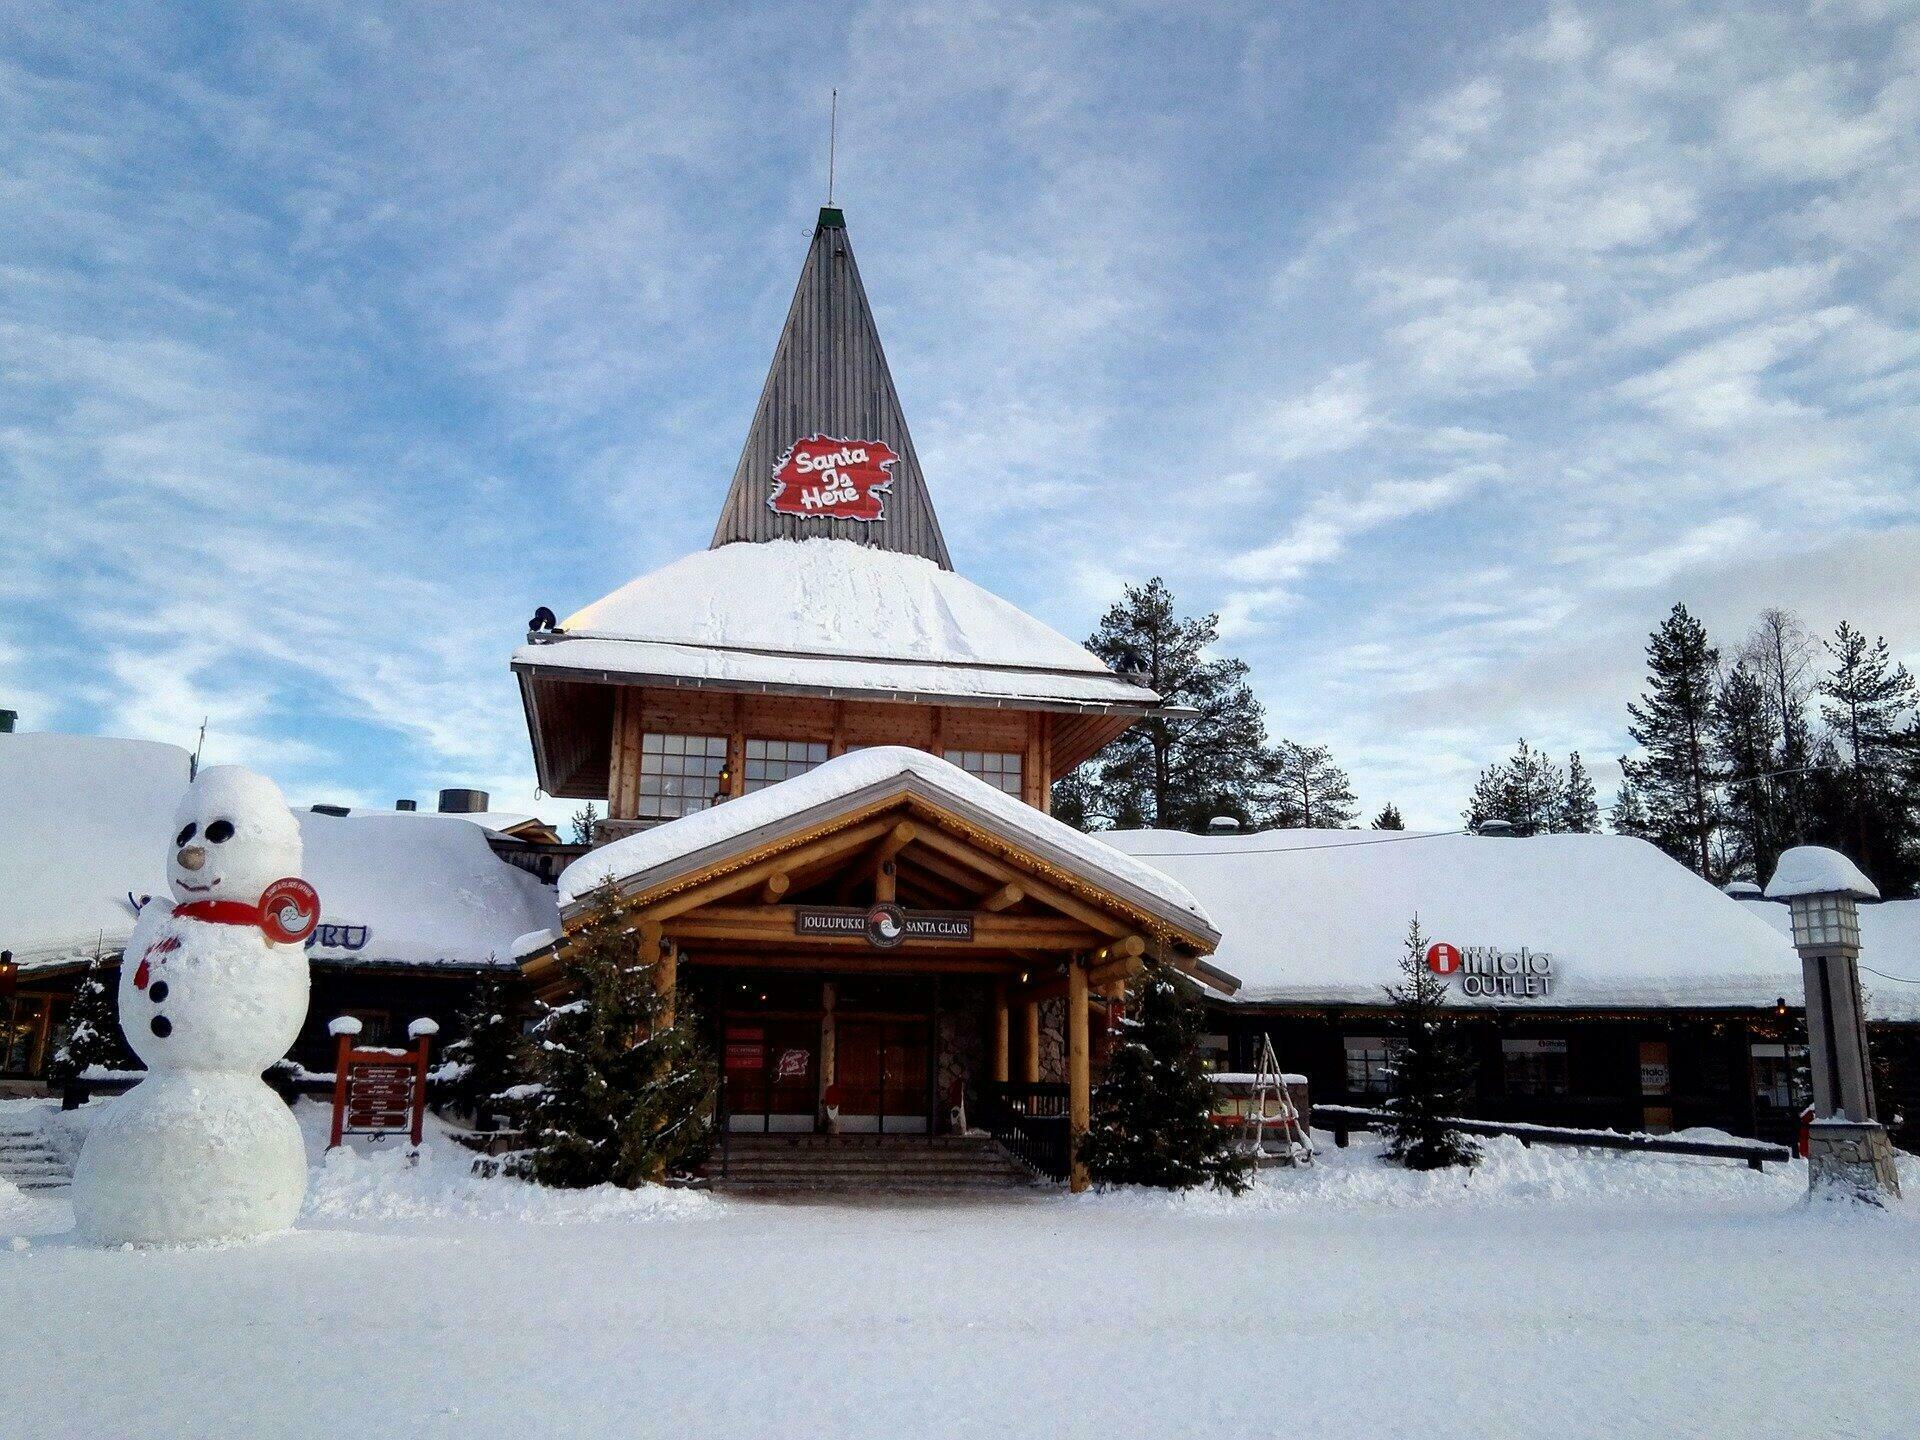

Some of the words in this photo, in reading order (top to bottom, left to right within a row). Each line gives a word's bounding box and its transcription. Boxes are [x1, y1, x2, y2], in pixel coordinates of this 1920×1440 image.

[795, 447, 869, 474] Santa
[822, 468, 853, 491] Is
[801, 487, 860, 510] Here
[804, 916, 865, 930] JOULUPUKKI
[906, 921, 936, 933] SANTA
[938, 922, 968, 934] CLAUS
[1462, 946, 1553, 974] iittala
[1464, 975, 1553, 995] OUTLET
